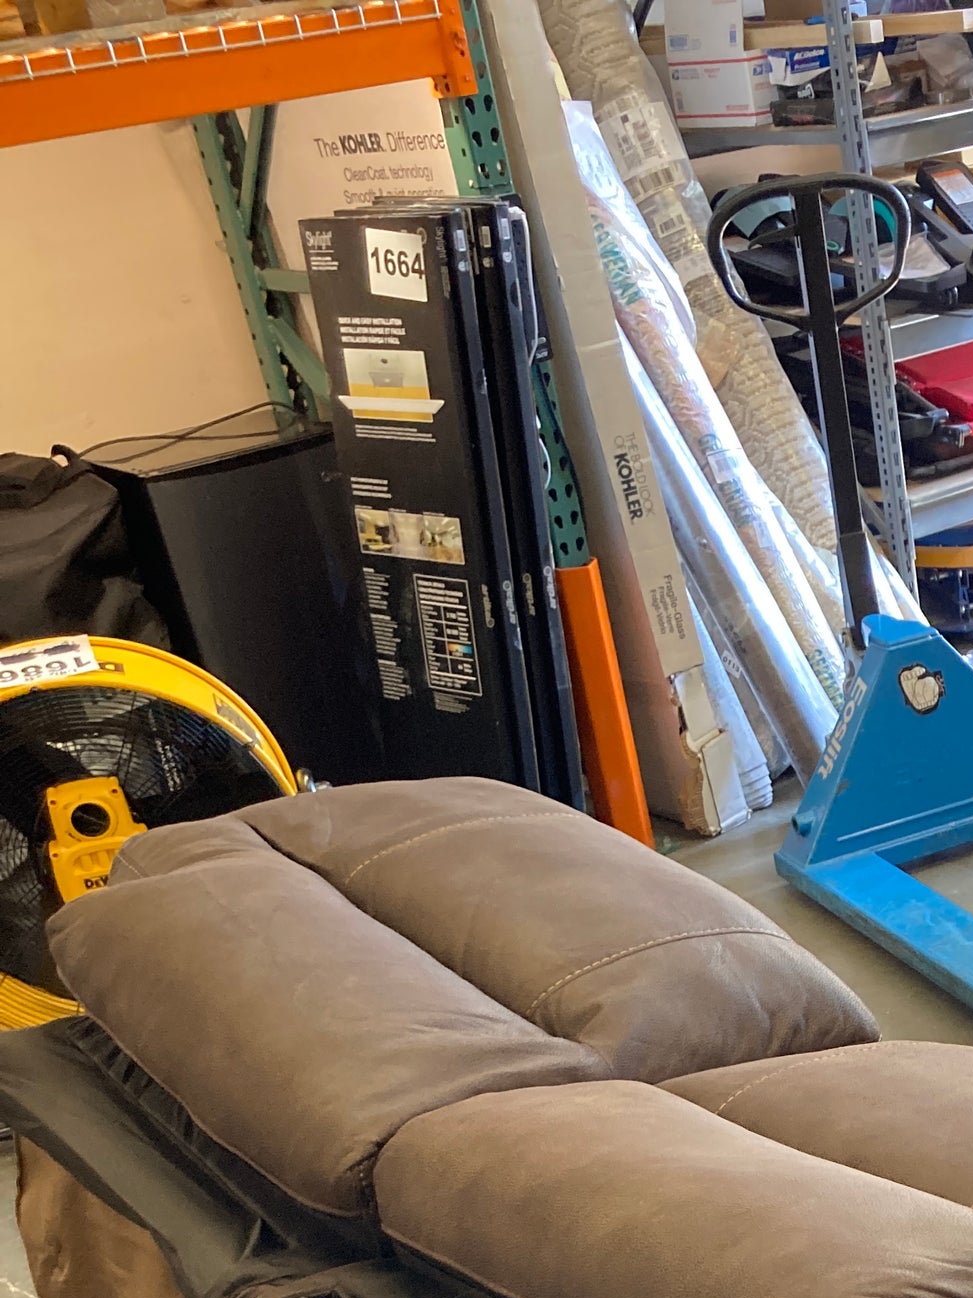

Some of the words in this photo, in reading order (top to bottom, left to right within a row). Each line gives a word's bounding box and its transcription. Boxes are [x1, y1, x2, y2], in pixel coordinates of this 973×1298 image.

[313, 138, 340, 158] The
[386, 131, 446, 152] Difference
[389, 164, 434, 182] technology
[370, 246, 425, 280] 1664
[613, 434, 626, 453] OF
[613, 452, 644, 521] KOHLER
[625, 432, 637, 454] THE
[631, 453, 647, 489] BOLD
[639, 486, 656, 518] LOOK
[663, 573, 686, 640] Fragile-Glass
[722, 656, 740, 673] 0113
[817, 676, 868, 780] Eoslift
